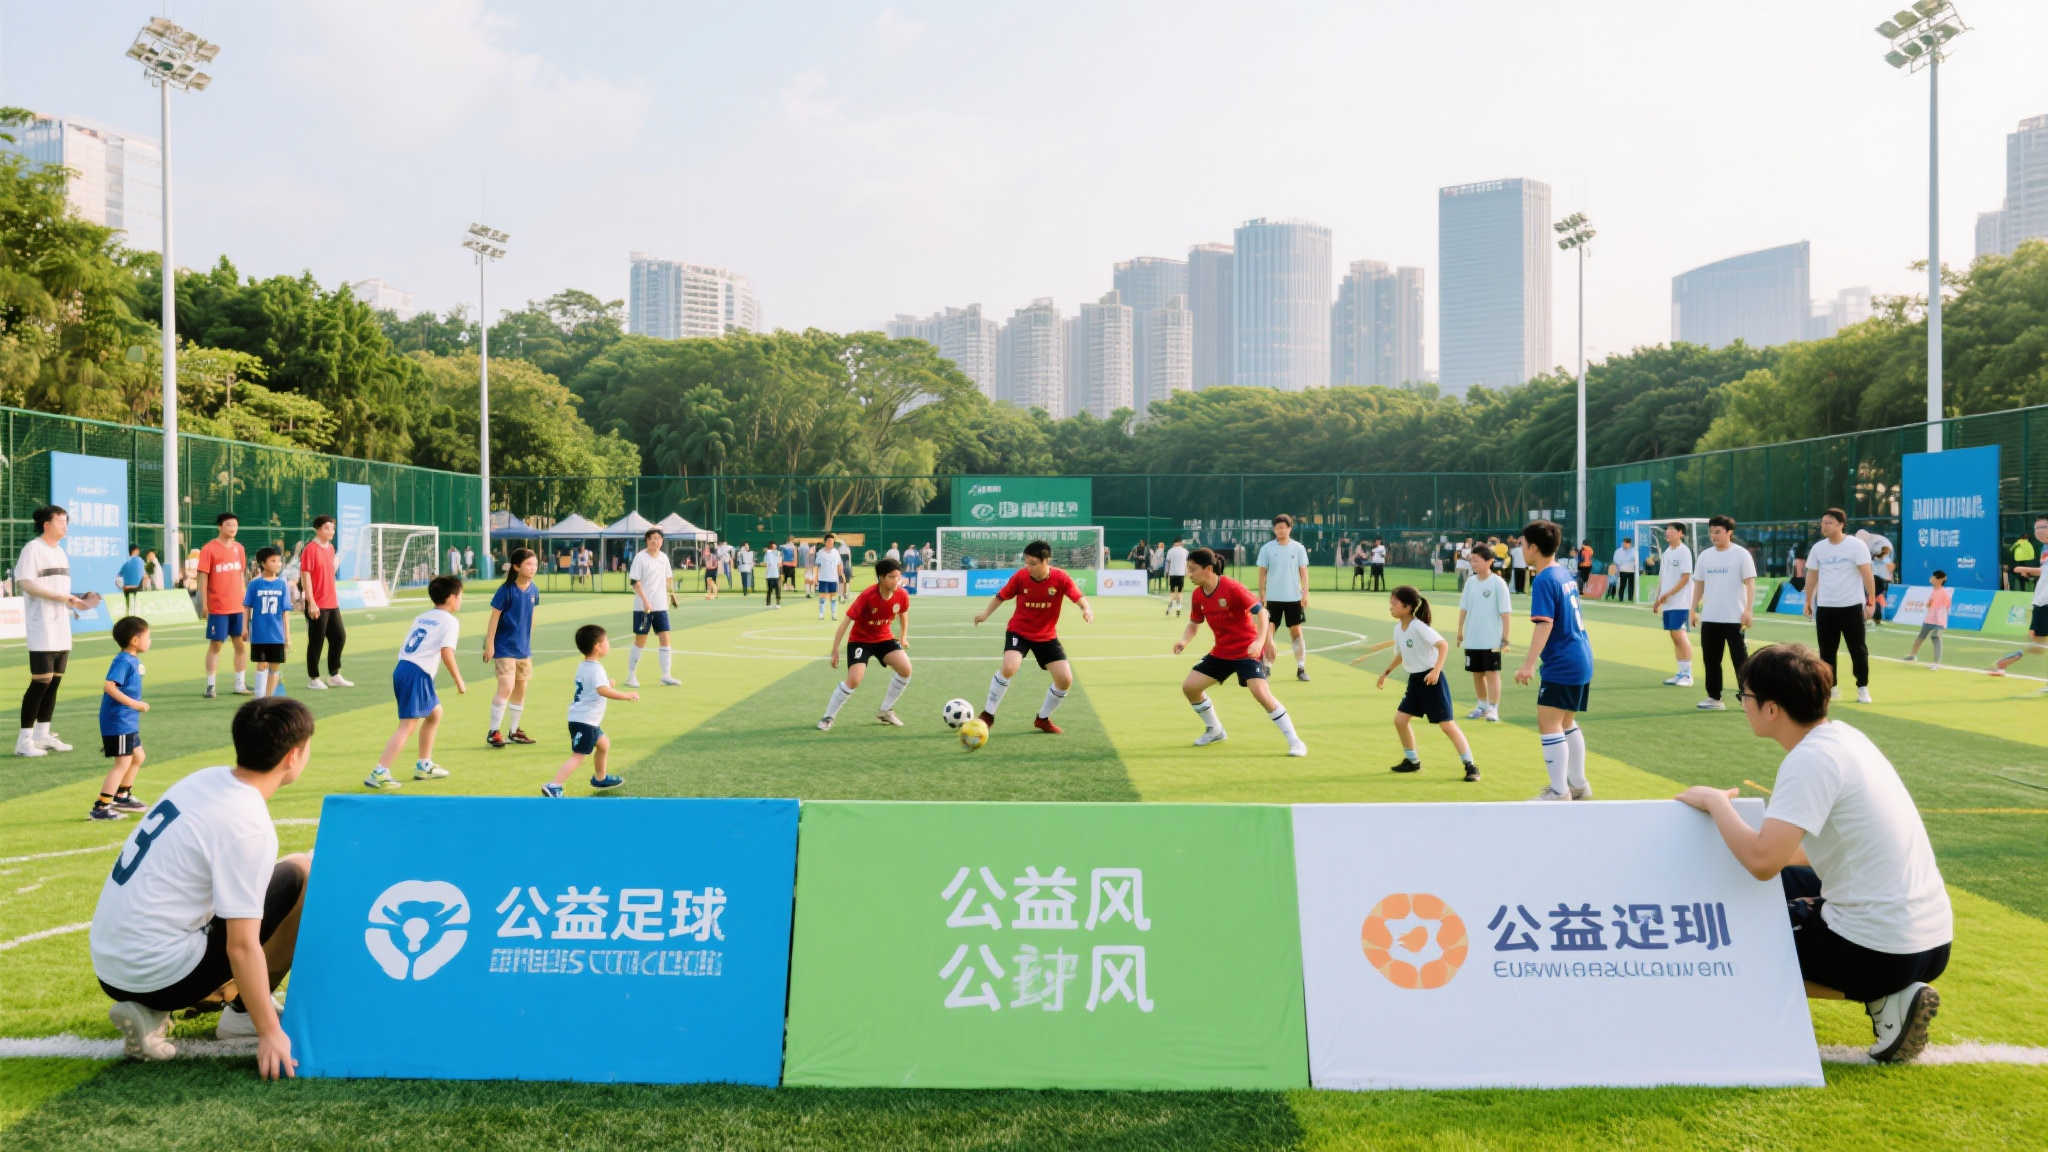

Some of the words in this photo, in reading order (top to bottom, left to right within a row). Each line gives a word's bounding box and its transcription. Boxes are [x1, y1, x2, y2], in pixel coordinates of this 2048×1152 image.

[112, 799, 180, 886] 3
[496, 886, 727, 941] 公益足球
[942, 866, 1152, 931] 公益风
